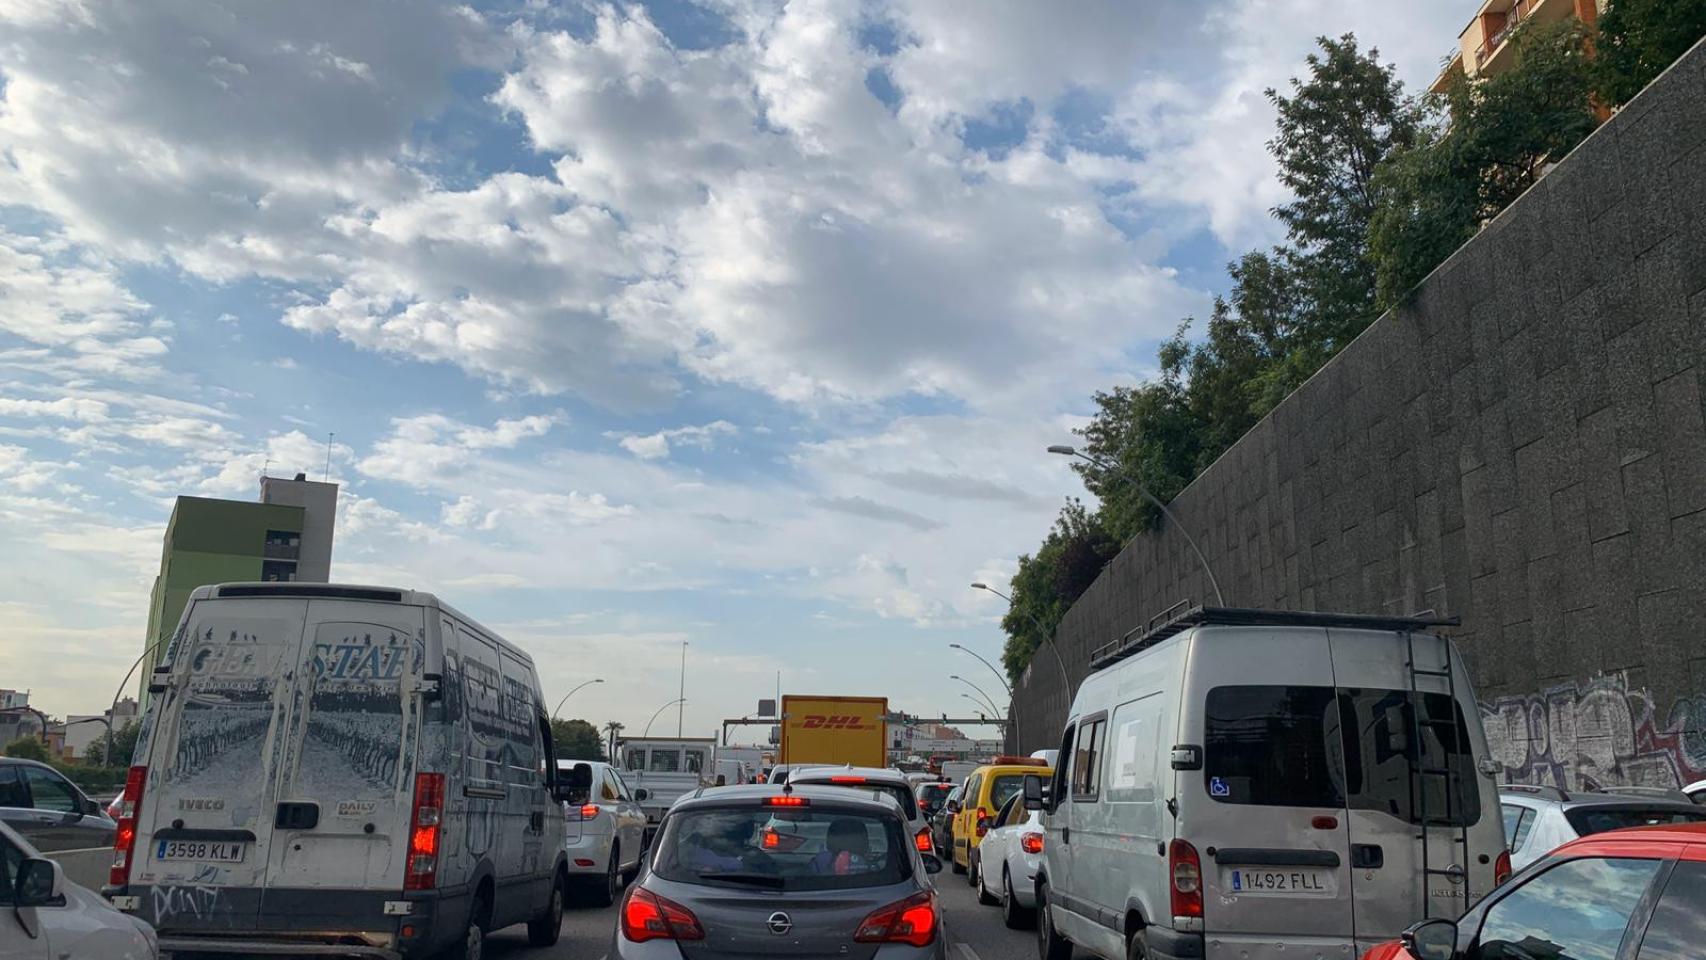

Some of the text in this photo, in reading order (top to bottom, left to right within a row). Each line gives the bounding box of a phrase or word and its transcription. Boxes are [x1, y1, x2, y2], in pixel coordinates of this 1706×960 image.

[803, 715, 864, 729] DHL
[179, 798, 225, 810] IVECO
[339, 802, 376, 811] DAILY
[167, 842, 241, 860] 3598 KLW
[1245, 873, 1324, 889] 1492 FLL
